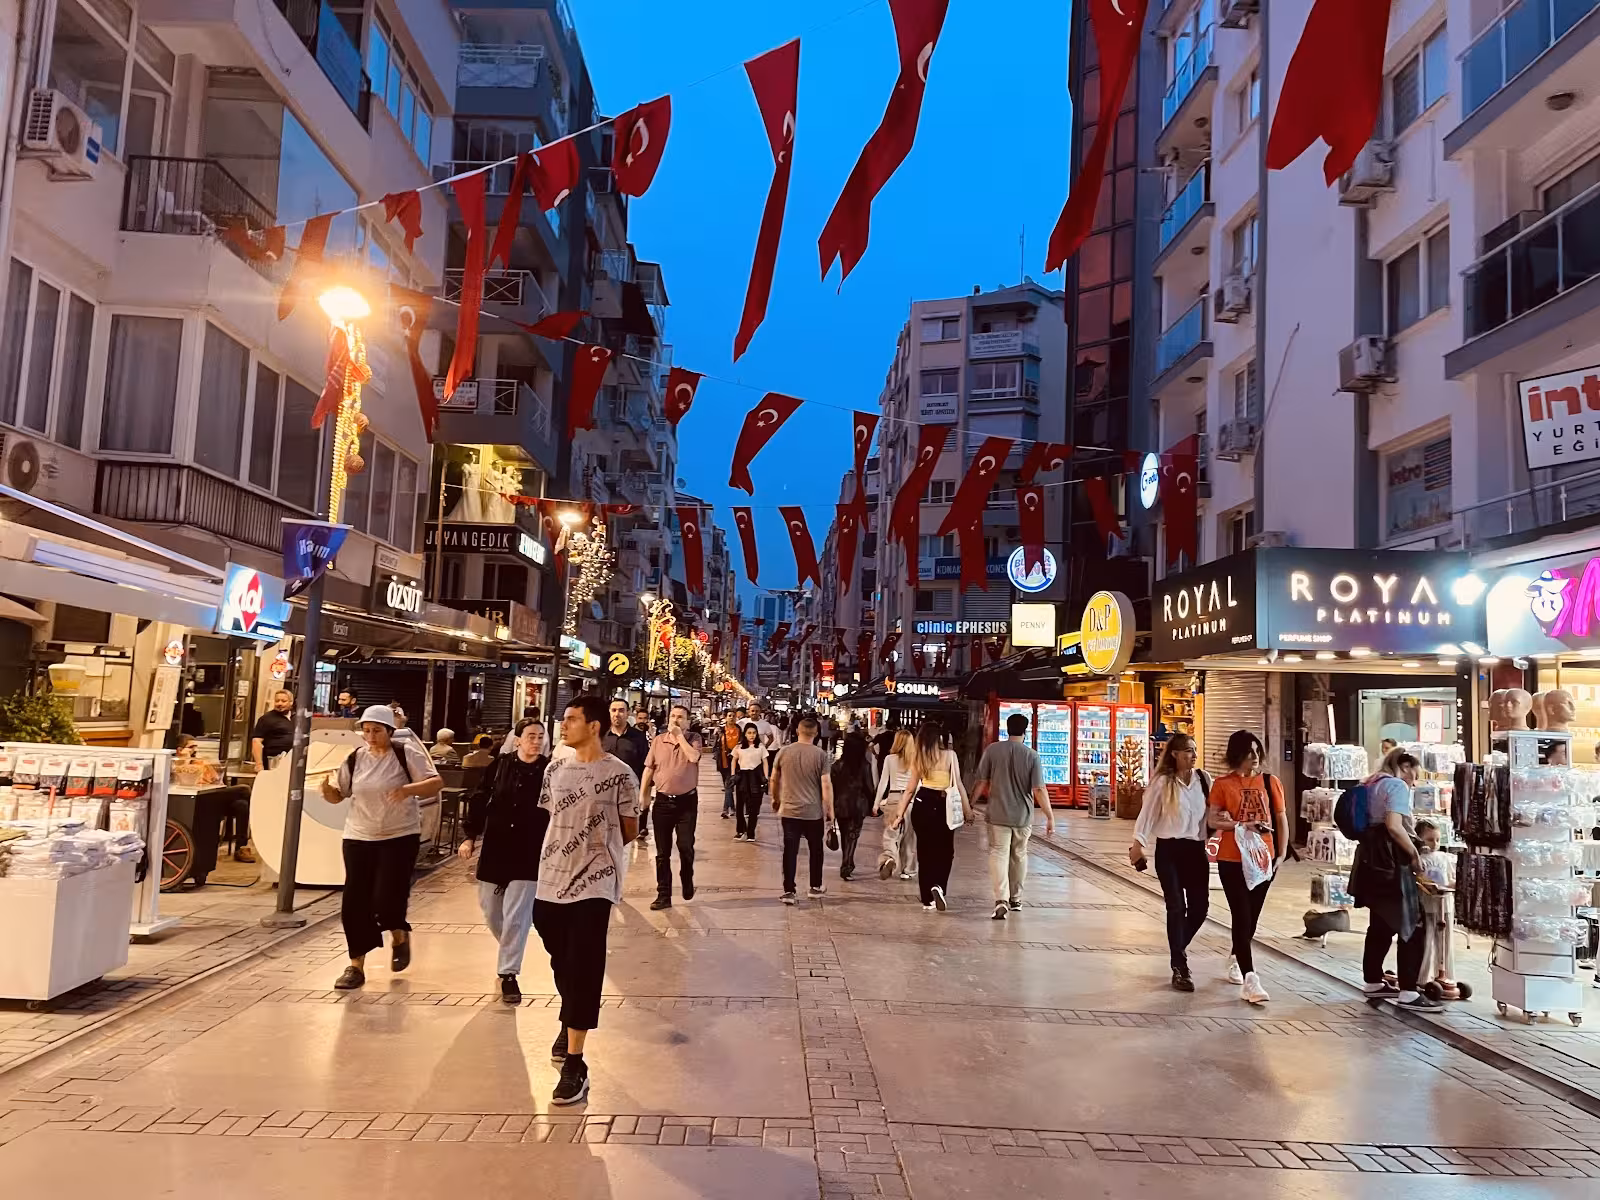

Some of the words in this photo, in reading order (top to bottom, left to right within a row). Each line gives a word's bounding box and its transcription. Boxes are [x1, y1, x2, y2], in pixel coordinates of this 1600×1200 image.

[1163, 575, 1238, 623] ROYAL
[1290, 571, 1440, 604] ROYA
[917, 620, 953, 633] clinic
[955, 621, 1008, 634] EPHESUS
[1020, 621, 1046, 629] PENNY
[1089, 604, 1111, 632] D&P
[1316, 608, 1452, 625] PLATINUM
[1172, 618, 1227, 641] PLATINUM
